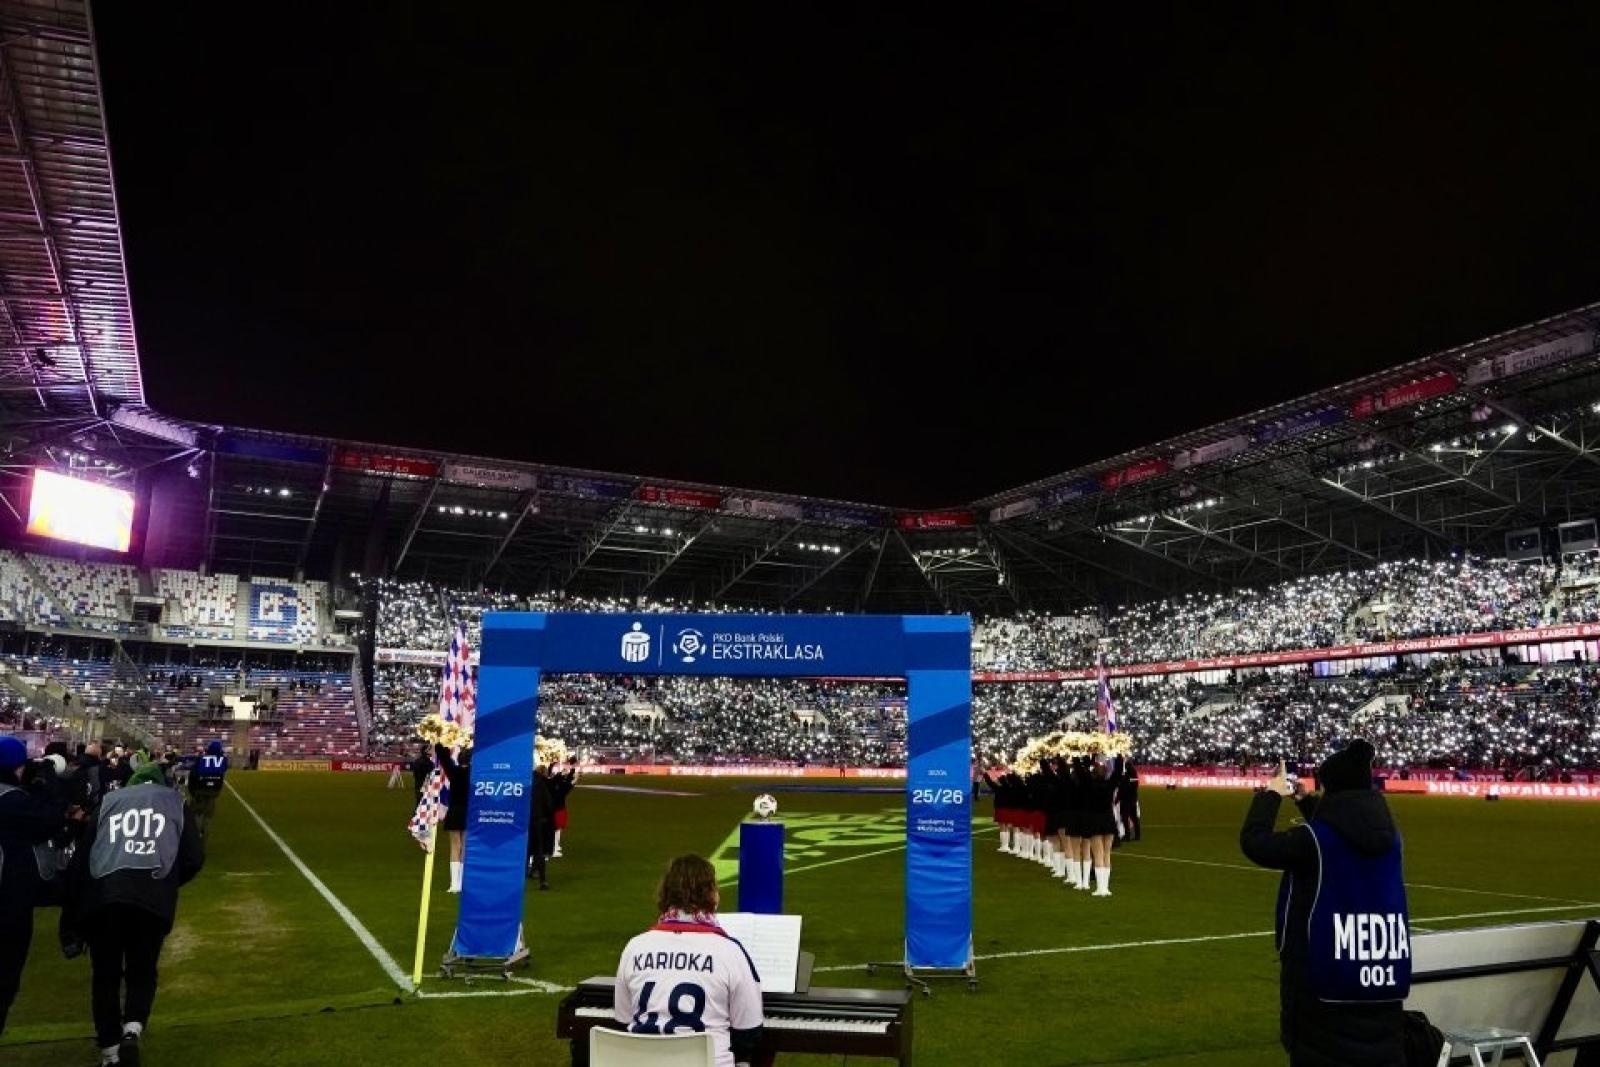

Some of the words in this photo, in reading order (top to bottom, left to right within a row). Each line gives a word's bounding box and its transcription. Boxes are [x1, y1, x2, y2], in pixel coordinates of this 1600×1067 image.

[1512, 346, 1574, 371] SZARMACH
[713, 633, 732, 642] PKO
[734, 633, 756, 642] Bank
[758, 633, 784, 642] Polski
[712, 644, 824, 661] EKSTRAKLASA
[202, 756, 224, 768] TV
[474, 781, 523, 797] 25/26
[912, 788, 963, 805] 25/26
[124, 839, 156, 855] 022
[1333, 912, 1409, 961] MEDIA
[633, 951, 714, 973] KARIOKA
[1359, 964, 1396, 987] 001
[631, 981, 706, 1034] 48
